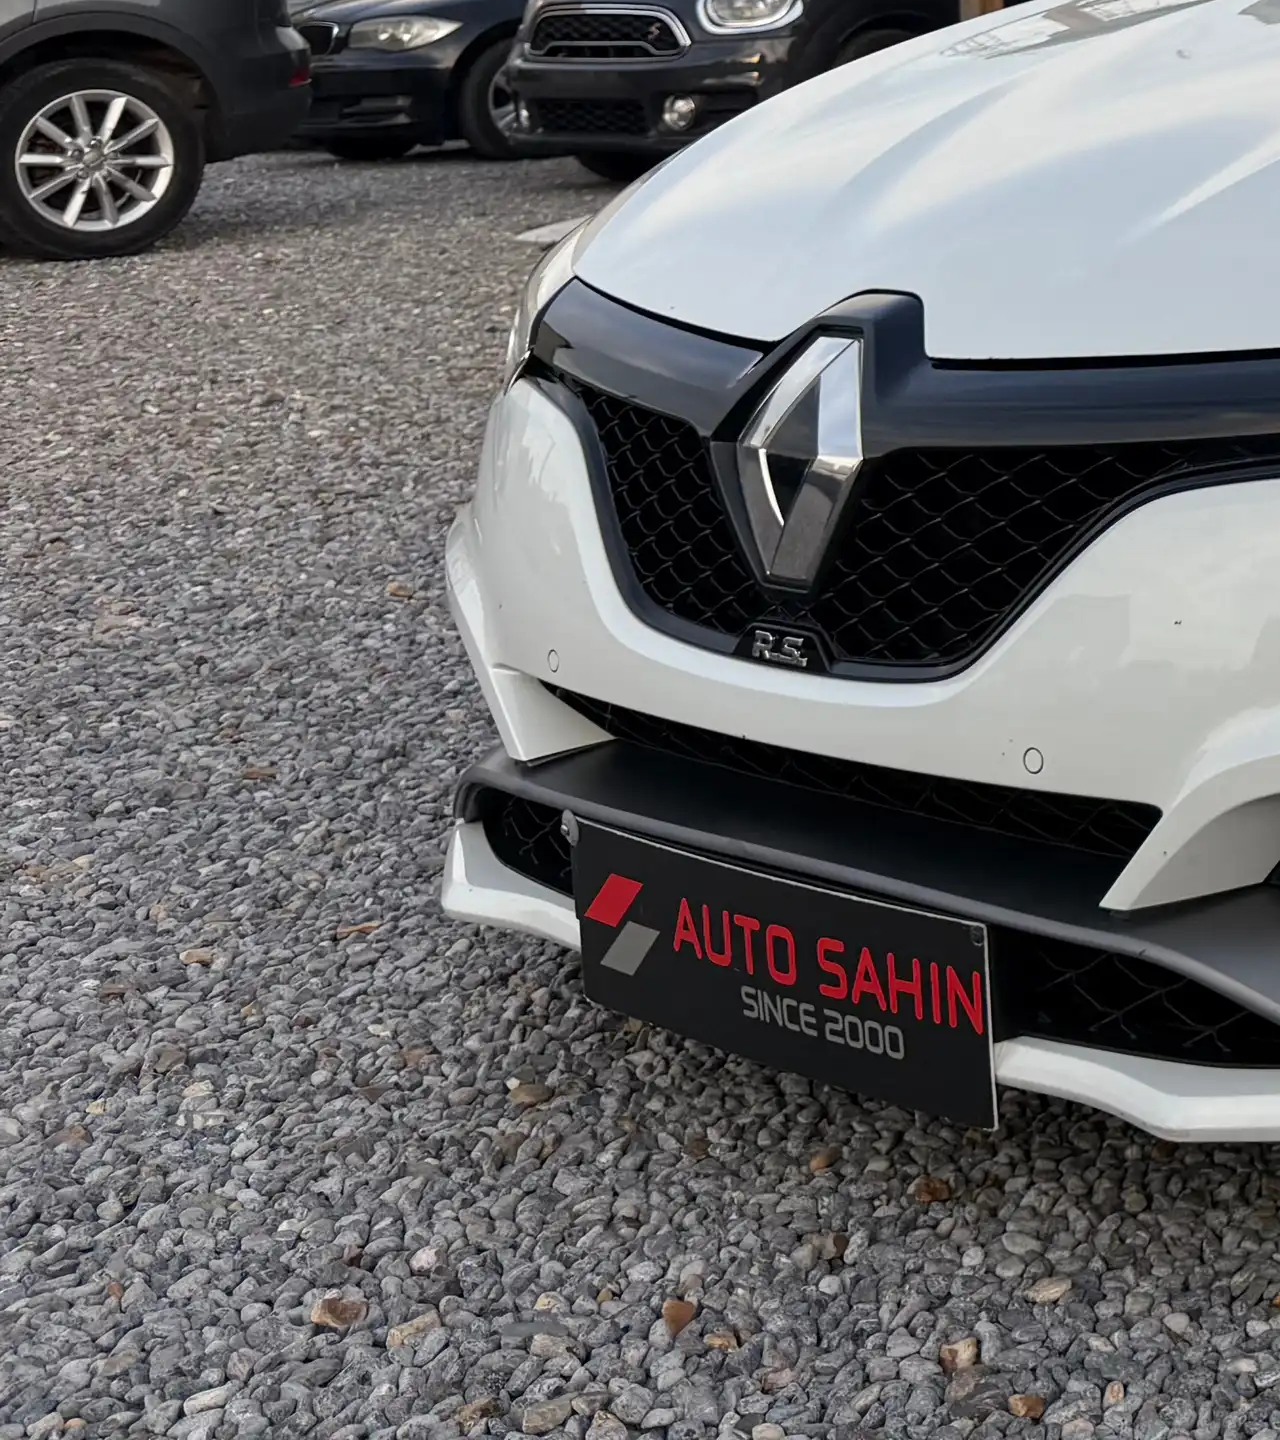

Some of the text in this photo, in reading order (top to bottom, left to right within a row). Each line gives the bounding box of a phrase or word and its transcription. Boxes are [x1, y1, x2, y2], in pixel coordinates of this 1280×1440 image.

[673, 897, 985, 1036] AUTO SAHIN
[740, 985, 905, 1061] SINCE 2000
